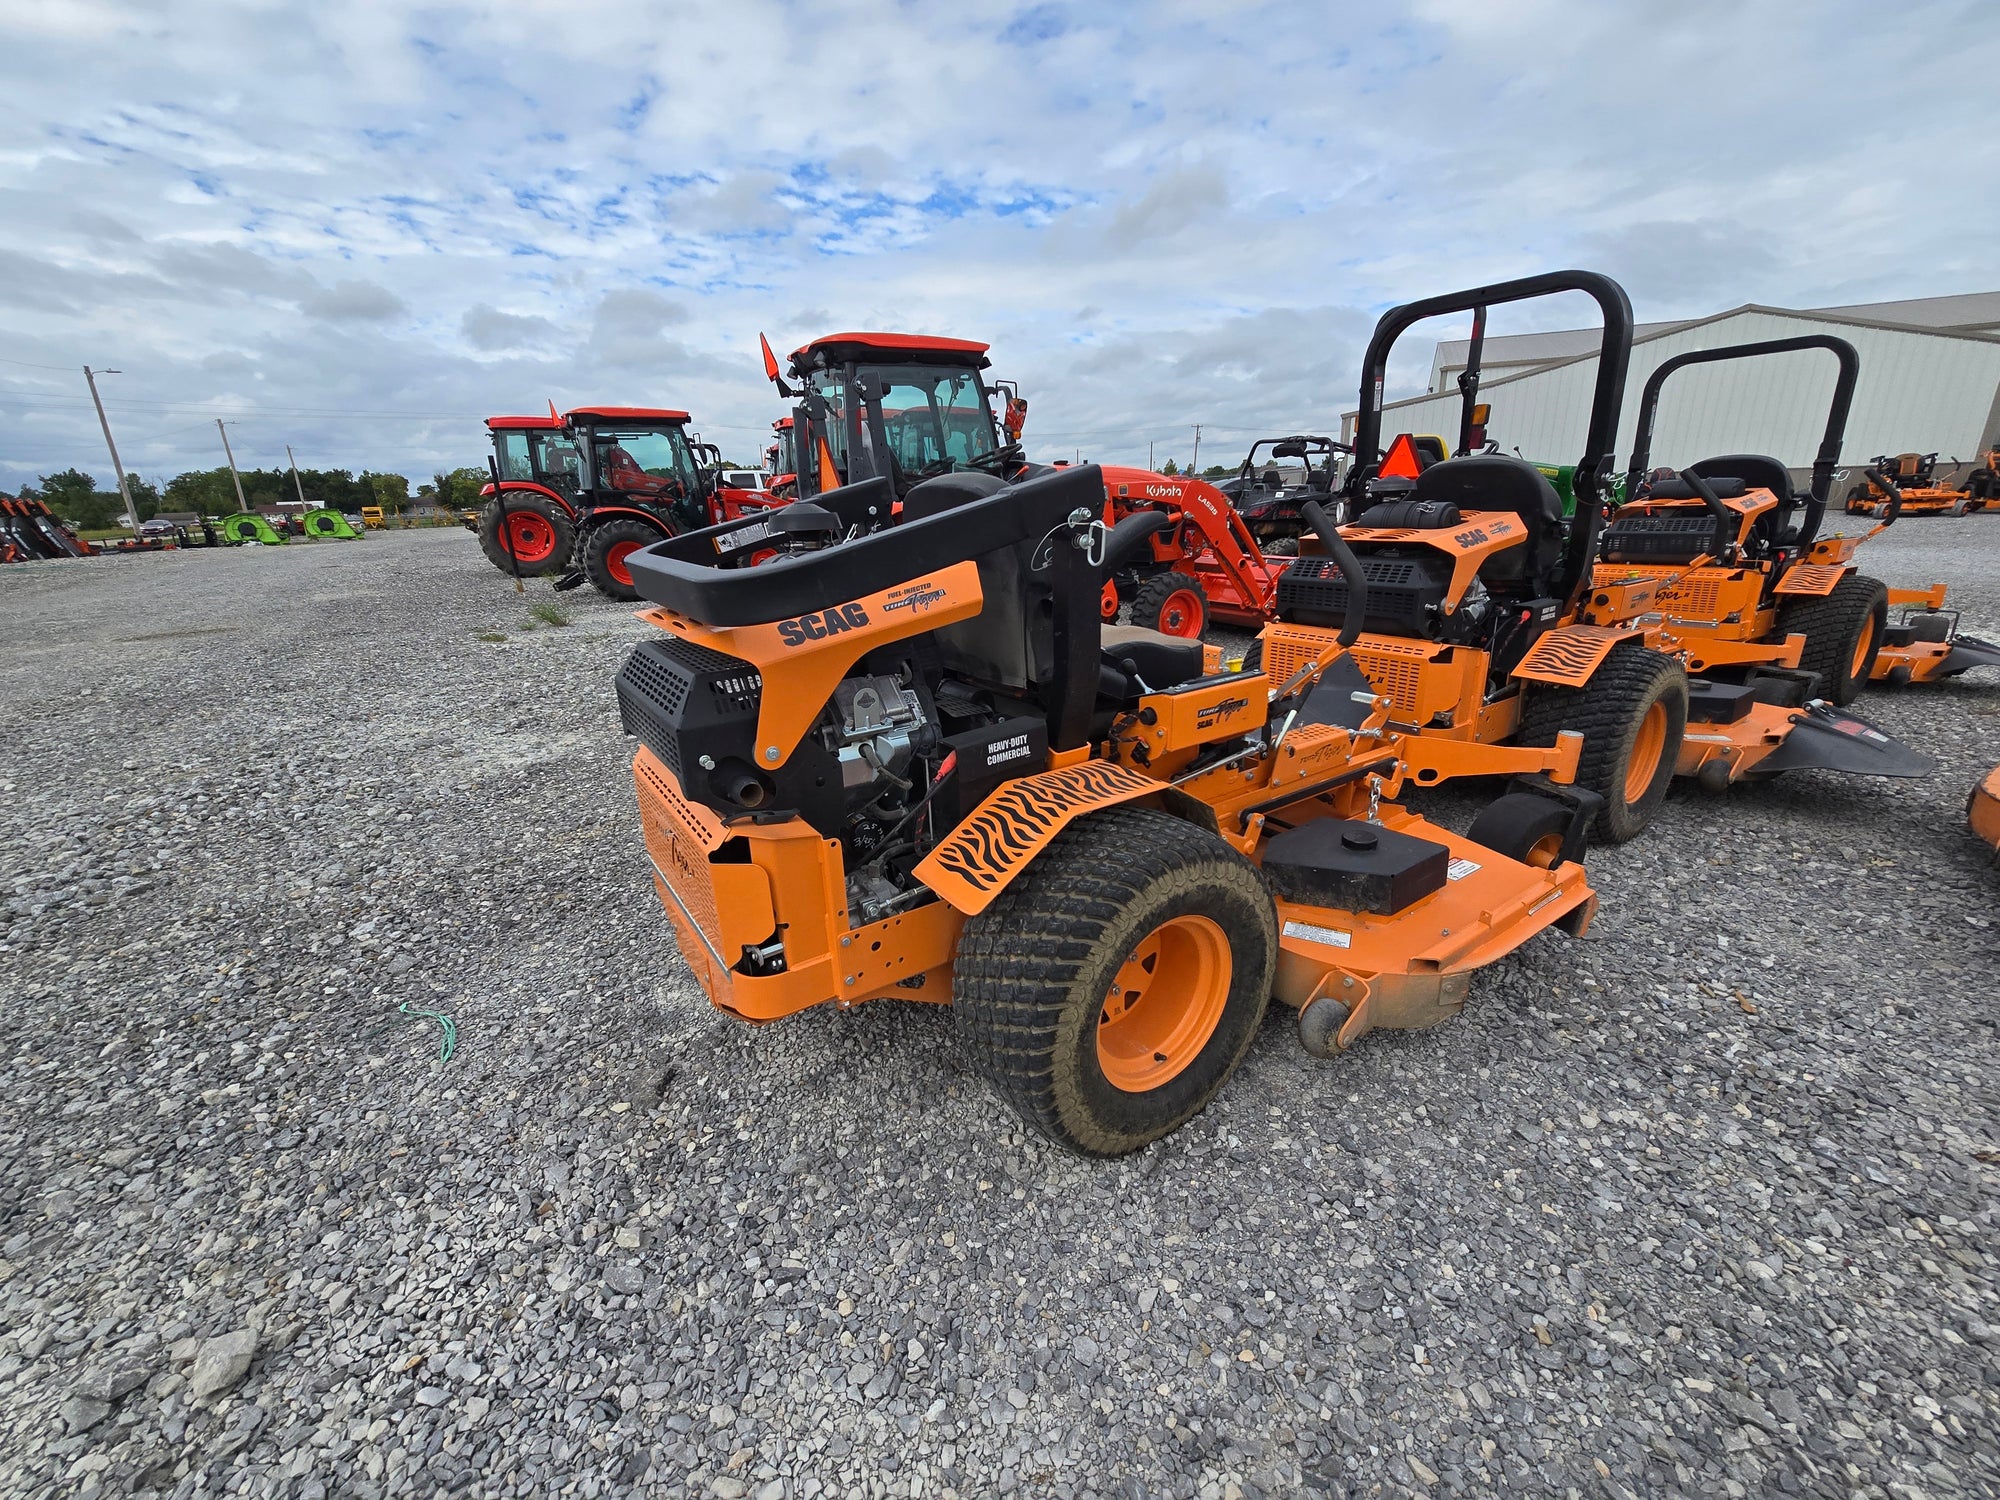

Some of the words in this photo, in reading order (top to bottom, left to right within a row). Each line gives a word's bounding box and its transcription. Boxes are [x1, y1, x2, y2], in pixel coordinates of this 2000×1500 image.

[1146, 485, 1182, 497] Kubota
[1454, 528, 1489, 549] SCAG
[887, 582, 932, 600] FUEL-INJECTED
[777, 602, 870, 647] SCAG
[988, 734, 1028, 754] HEAVY-DUTY
[987, 745, 1031, 766] COMMERCIAL
